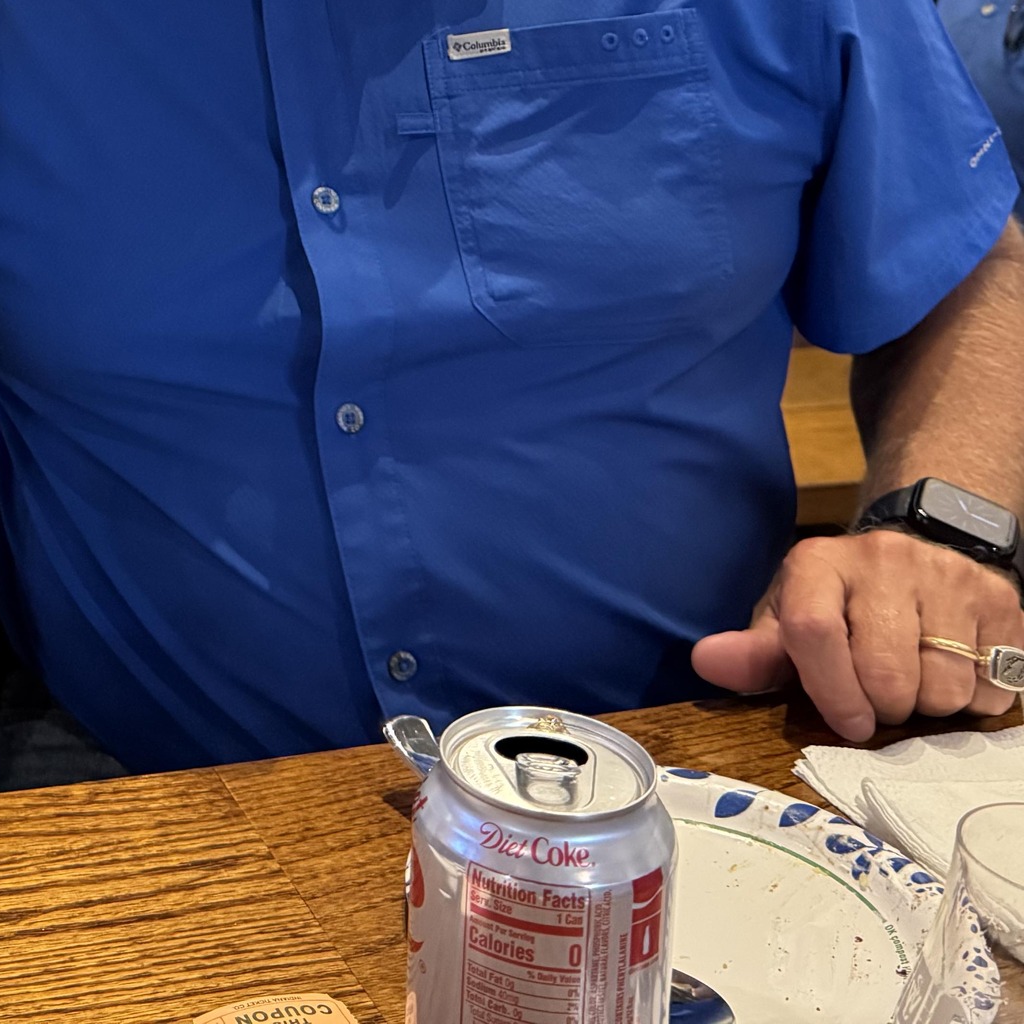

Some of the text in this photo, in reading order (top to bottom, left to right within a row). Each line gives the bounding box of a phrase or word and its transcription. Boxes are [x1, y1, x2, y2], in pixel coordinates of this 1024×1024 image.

[463, 38, 506, 51] Columbia
[480, 822, 528, 858] Diet
[472, 868, 585, 910] Nutrition Facts
[470, 890, 513, 915] Serv. Size
[565, 914, 583, 926] Can
[884, 924, 897, 936] OK
[469, 925, 535, 963] Calories
[568, 943, 582, 967] 0
[466, 976, 496, 995] Sodium
[467, 962, 515, 991] Total Fat 0g
[537, 972, 557, 984] Daily
[247, 999, 271, 1008] TICKET
[272, 995, 302, 1004] INDIANA
[466, 989, 486, 1006] Total
[487, 999, 511, 1015] Carb.
[513, 1008, 523, 1021] 0g
[234, 1004, 333, 1024] COUPON
